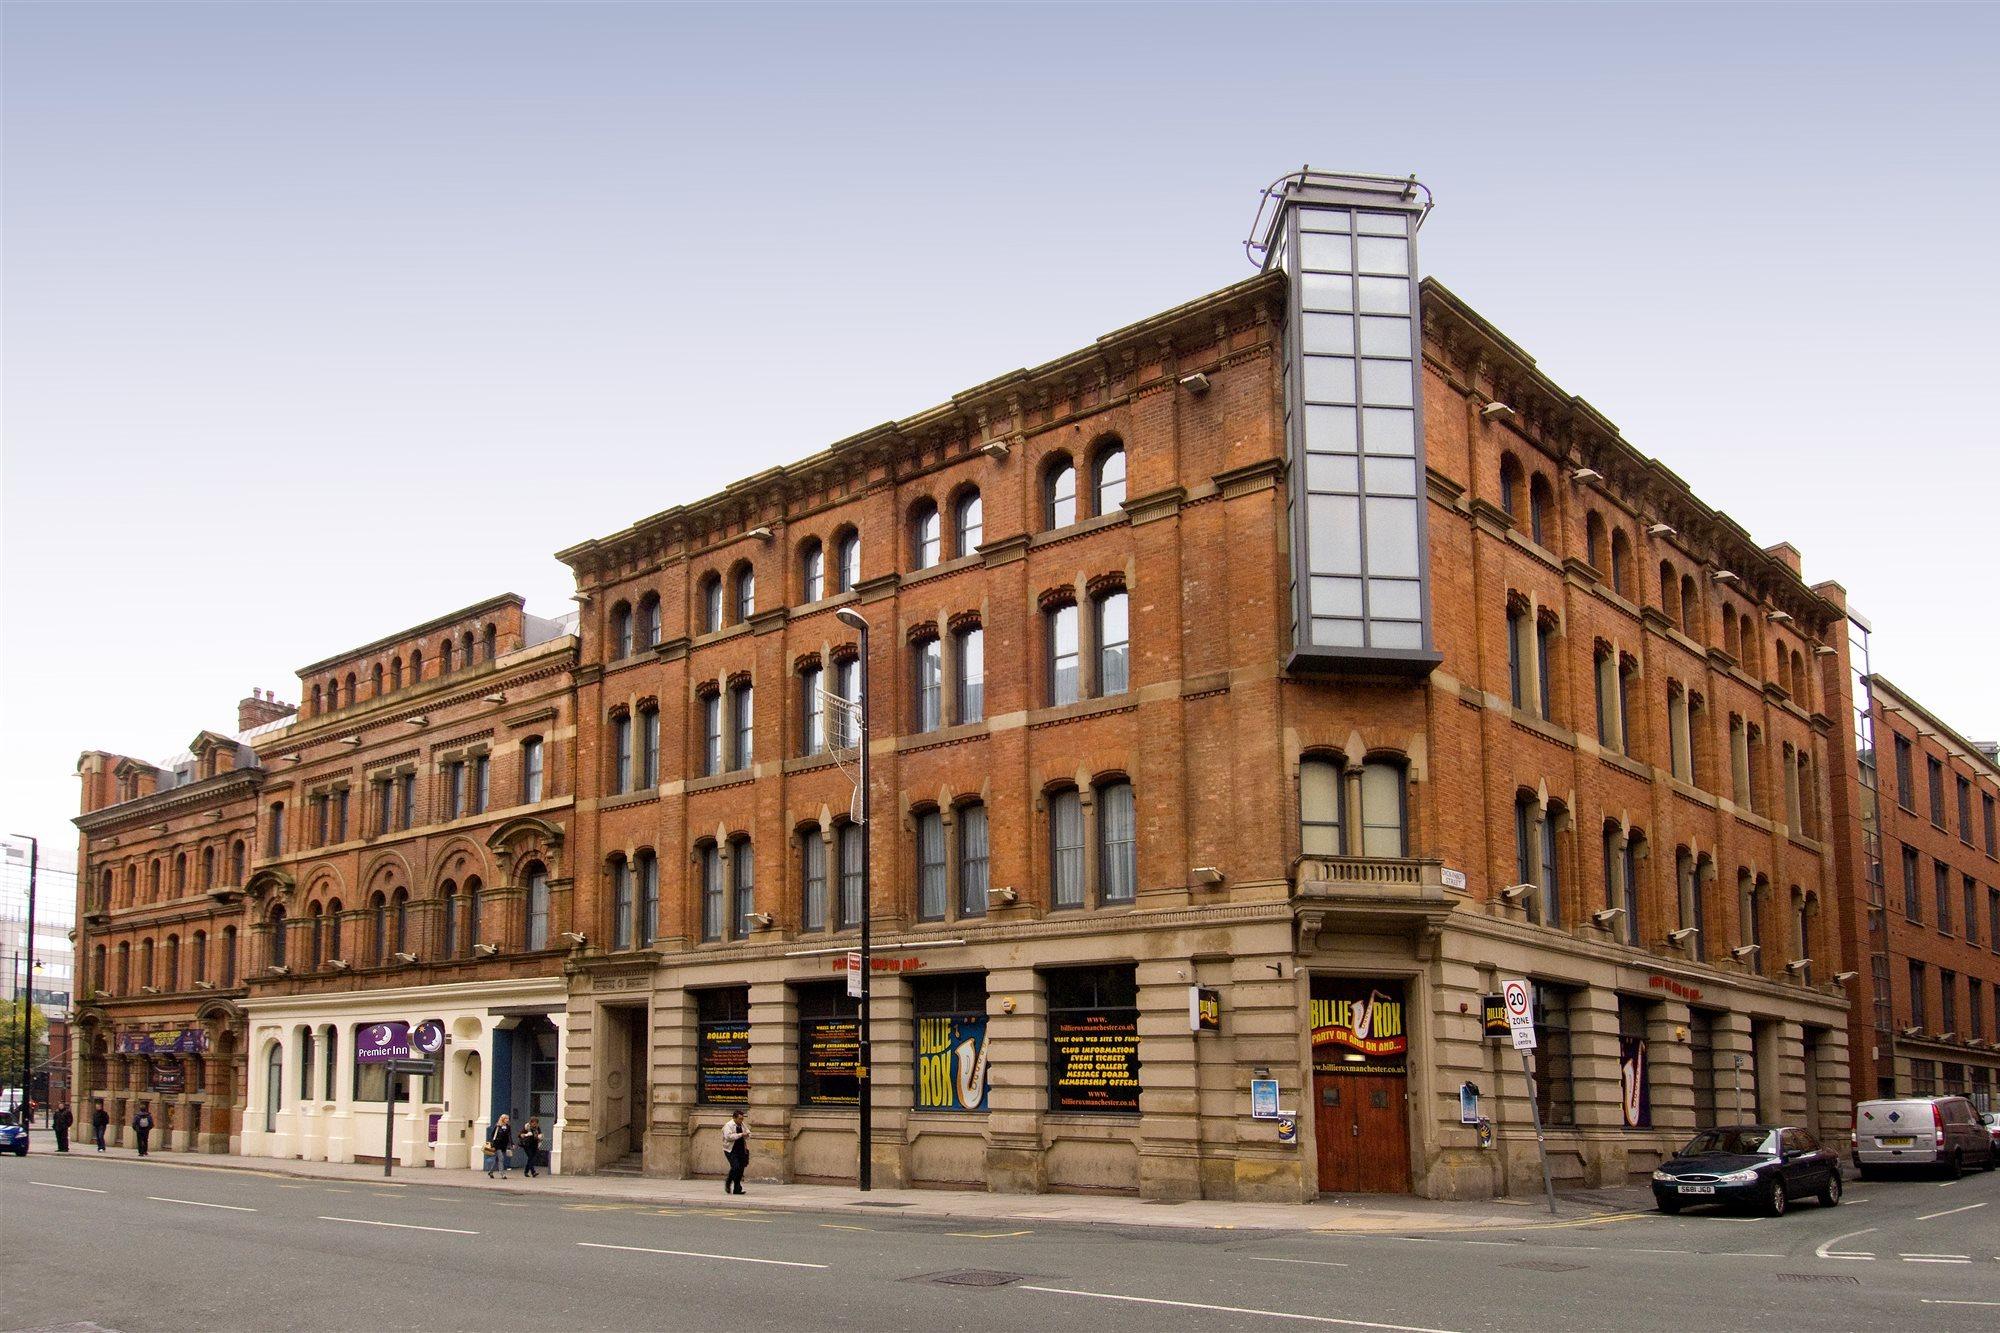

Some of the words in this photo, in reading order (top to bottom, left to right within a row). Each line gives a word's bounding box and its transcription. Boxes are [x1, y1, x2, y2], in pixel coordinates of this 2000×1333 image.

[1509, 993, 1524, 1006] 20
[1310, 999, 1353, 1030] BILLIE
[1373, 1001, 1402, 1038] ROX
[1512, 1016, 1530, 1025] ZONE
[706, 1032, 731, 1040] ROLLER
[732, 1031, 749, 1040] DISC
[920, 1017, 952, 1054] BILLIE
[1311, 1031, 1335, 1043] PARTY
[1336, 1030, 1348, 1040] ON
[1365, 1041, 1377, 1052] ON
[358, 1047, 391, 1057] Premier
[392, 1045, 408, 1055] Inn
[1061, 1046, 1080, 1054] CLUB
[1081, 1046, 1135, 1054] INFORMATION
[1070, 1054, 1094, 1062] EVENT
[1095, 1054, 1126, 1062] TICKETS
[1095, 1062, 1129, 1070] GALLERY
[1312, 1064, 1405, 1073] ww.billieroxmanchester.co.uk
[920, 1050, 953, 1107] ROX
[1058, 1078, 1107, 1086] MEMBERSHIP
[1108, 1078, 1138, 1086] OFFERS
